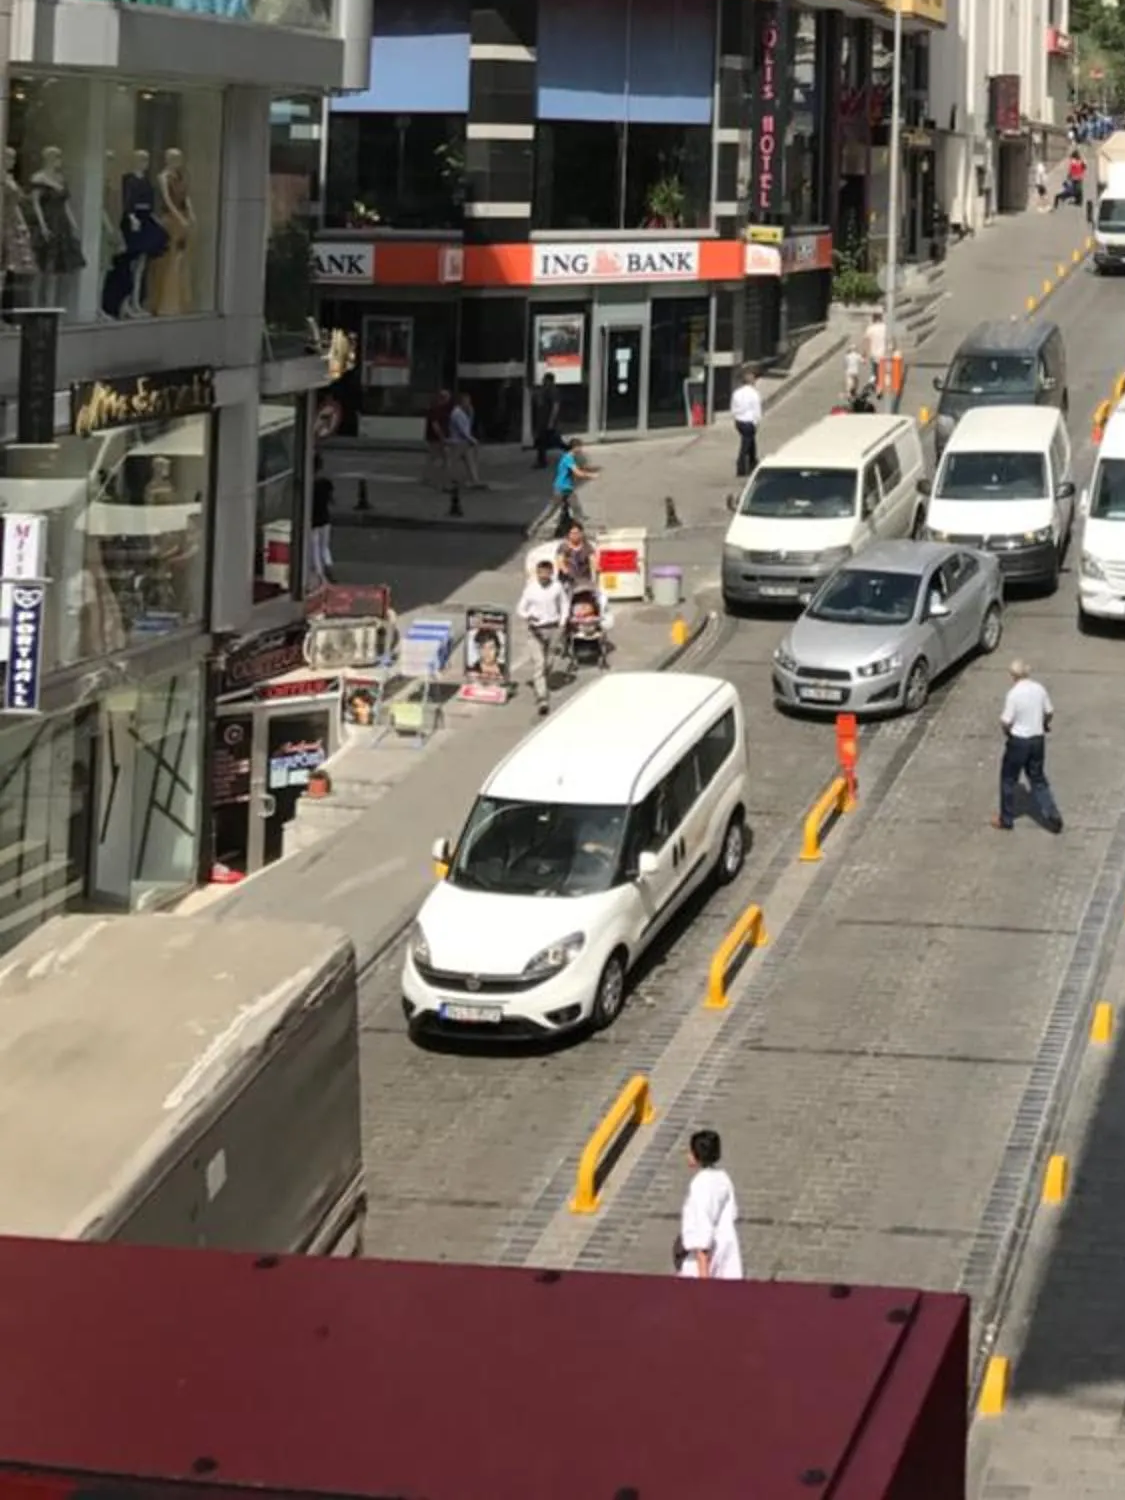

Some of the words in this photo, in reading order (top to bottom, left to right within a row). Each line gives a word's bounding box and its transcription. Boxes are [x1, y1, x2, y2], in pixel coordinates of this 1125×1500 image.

[759, 115, 776, 208] HOTEL
[541, 253, 589, 275] ING
[626, 251, 693, 273] BANK
